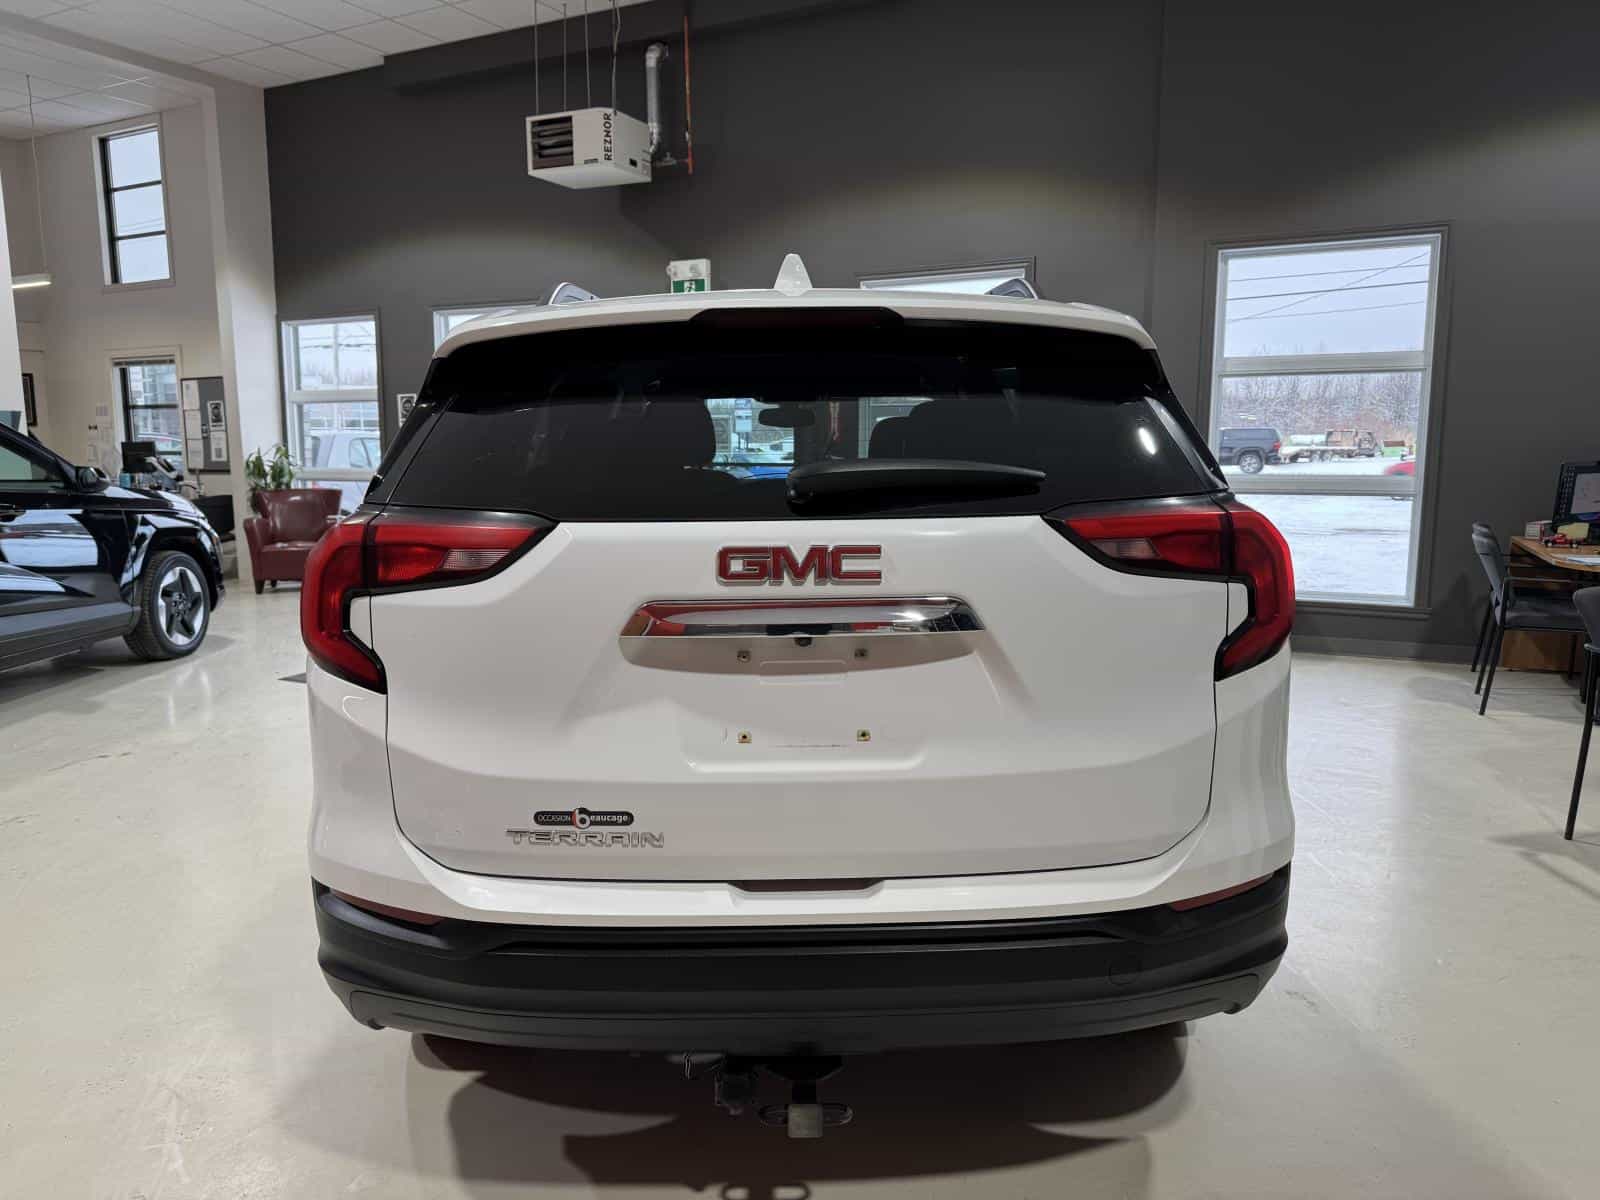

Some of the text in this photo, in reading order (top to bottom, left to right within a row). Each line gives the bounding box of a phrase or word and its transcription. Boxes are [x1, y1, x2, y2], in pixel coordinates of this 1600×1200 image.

[603, 112, 612, 161] REZNOR
[716, 544, 882, 586] GMC
[506, 830, 664, 848] TERRAIN
